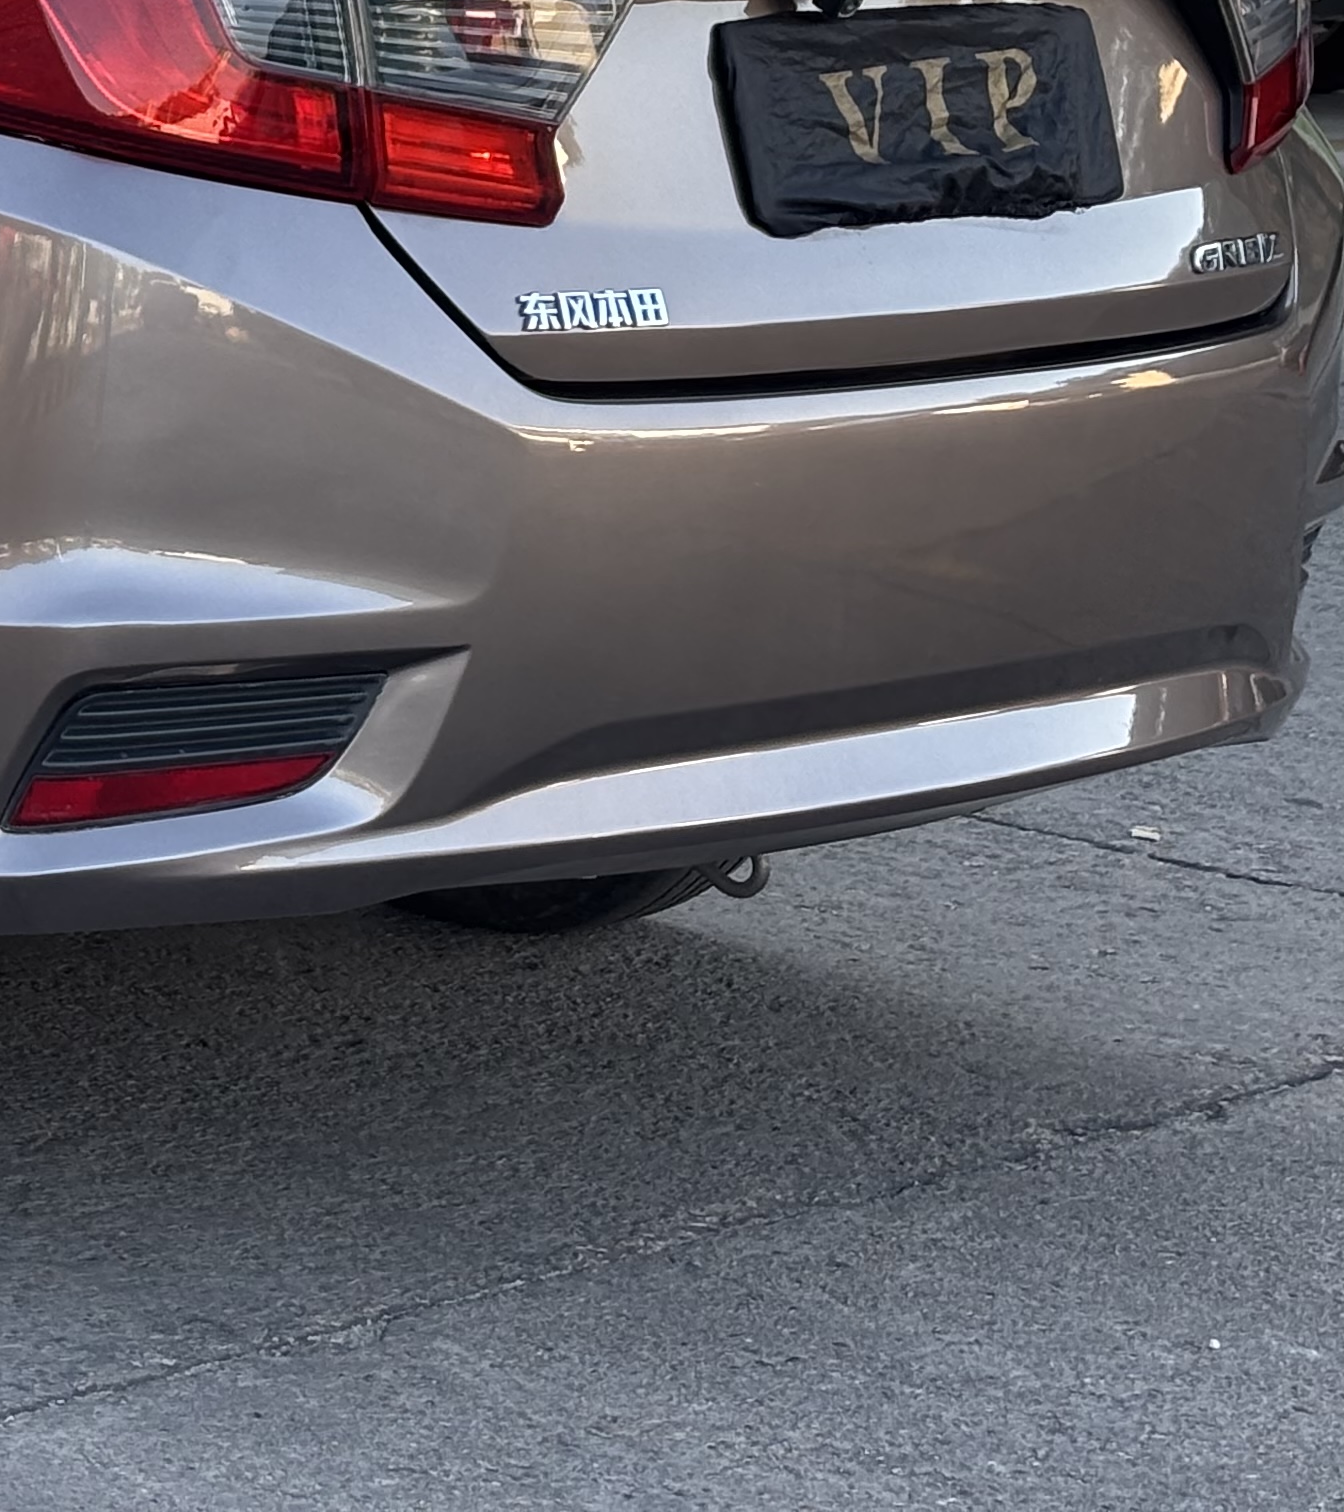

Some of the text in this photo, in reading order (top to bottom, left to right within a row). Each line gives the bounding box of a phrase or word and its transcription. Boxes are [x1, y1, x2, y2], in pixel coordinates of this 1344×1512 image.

[818, 48, 1041, 165] VIP
[516, 287, 670, 332] 东风本田
